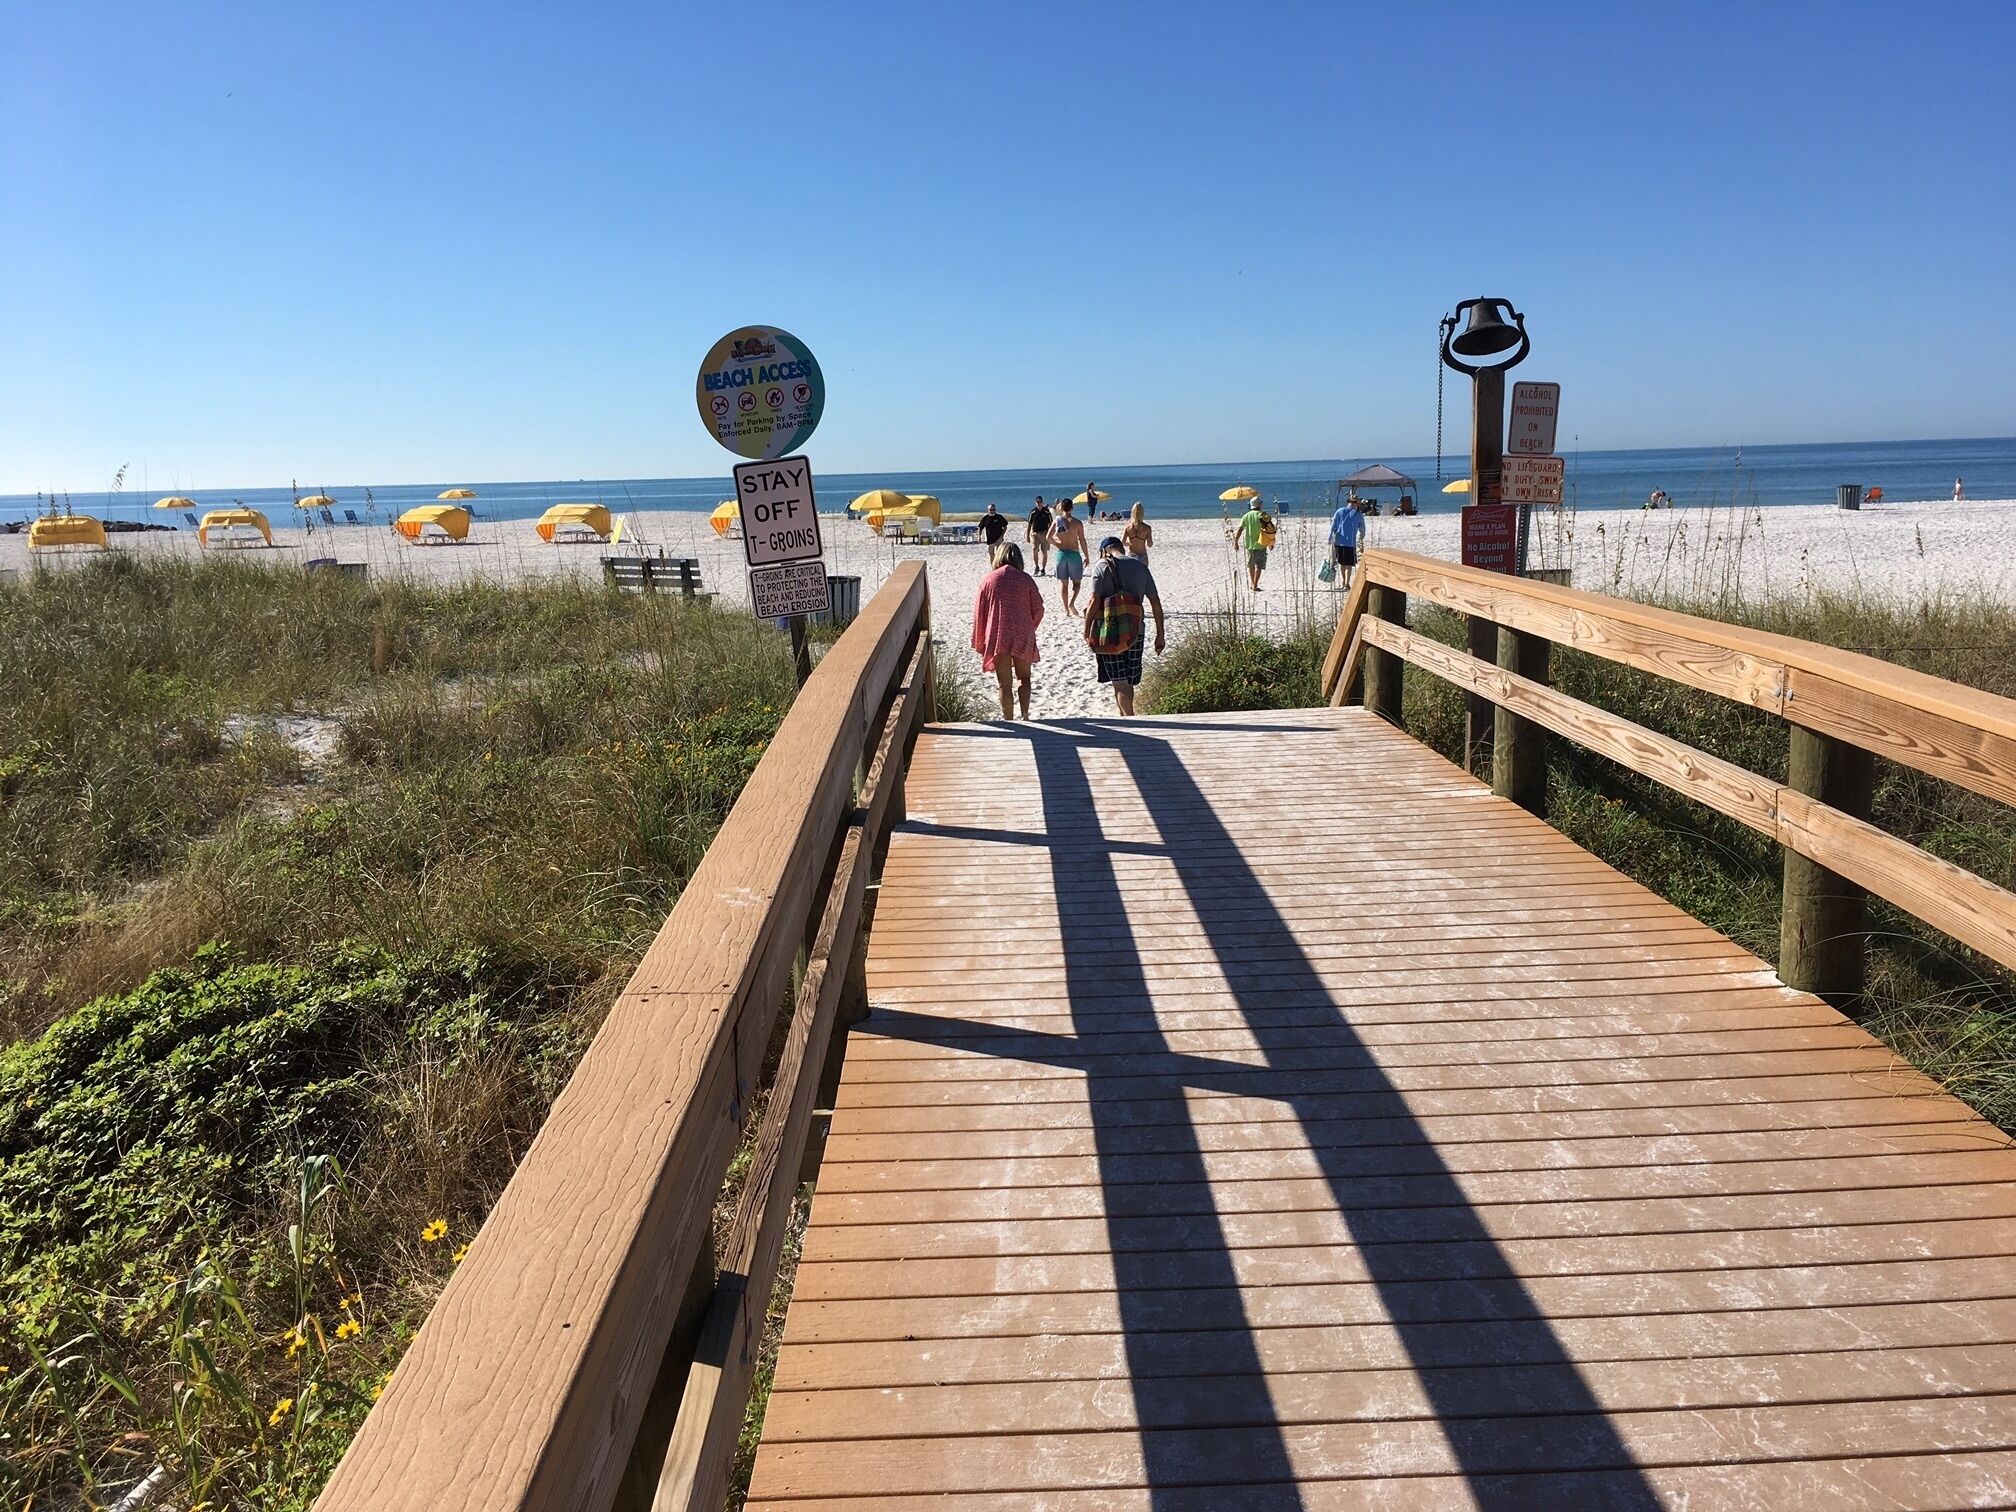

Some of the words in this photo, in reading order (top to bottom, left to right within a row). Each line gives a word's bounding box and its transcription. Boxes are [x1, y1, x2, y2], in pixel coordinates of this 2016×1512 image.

[704, 367, 754, 392] BEACH
[758, 359, 813, 384] ACCESS
[1520, 389, 1553, 400] ALCOHOL
[1515, 405, 1554, 416] PROHIBITED
[718, 422, 733, 431] Pay
[734, 420, 744, 428] for
[747, 416, 774, 426] Parking
[776, 413, 786, 422] by
[788, 411, 811, 421] Space
[1528, 422, 1538, 432] ON
[718, 428, 752, 439] Enforced
[1520, 438, 1543, 449] BEACH
[1502, 461, 1511, 471] NO
[1517, 461, 1557, 472] LIFEGUARD
[743, 468, 804, 493] STAY
[1501, 475, 1509, 484] N
[1540, 476, 1558, 485] SWIM
[1516, 487, 1531, 497] OWN
[1536, 488, 1554, 498] RISK
[754, 499, 800, 522] OFF
[1491, 522, 1505, 530] PLAN
[1467, 543, 1477, 552] No
[1479, 541, 1510, 551] Alcohol
[1473, 554, 1504, 564] Beyond
[754, 570, 783, 583] T-GROINS
[785, 568, 796, 580] ARE
[797, 565, 822, 578] CRITICAL
[756, 584, 765, 594] TO
[767, 578, 808, 592] PROTECTING
[810, 576, 823, 586] THE
[758, 593, 779, 605] BEACH
[780, 591, 794, 602] AND
[795, 587, 825, 600] REDUCING
[761, 603, 789, 616] BEACH
[791, 598, 826, 612] EROSION
